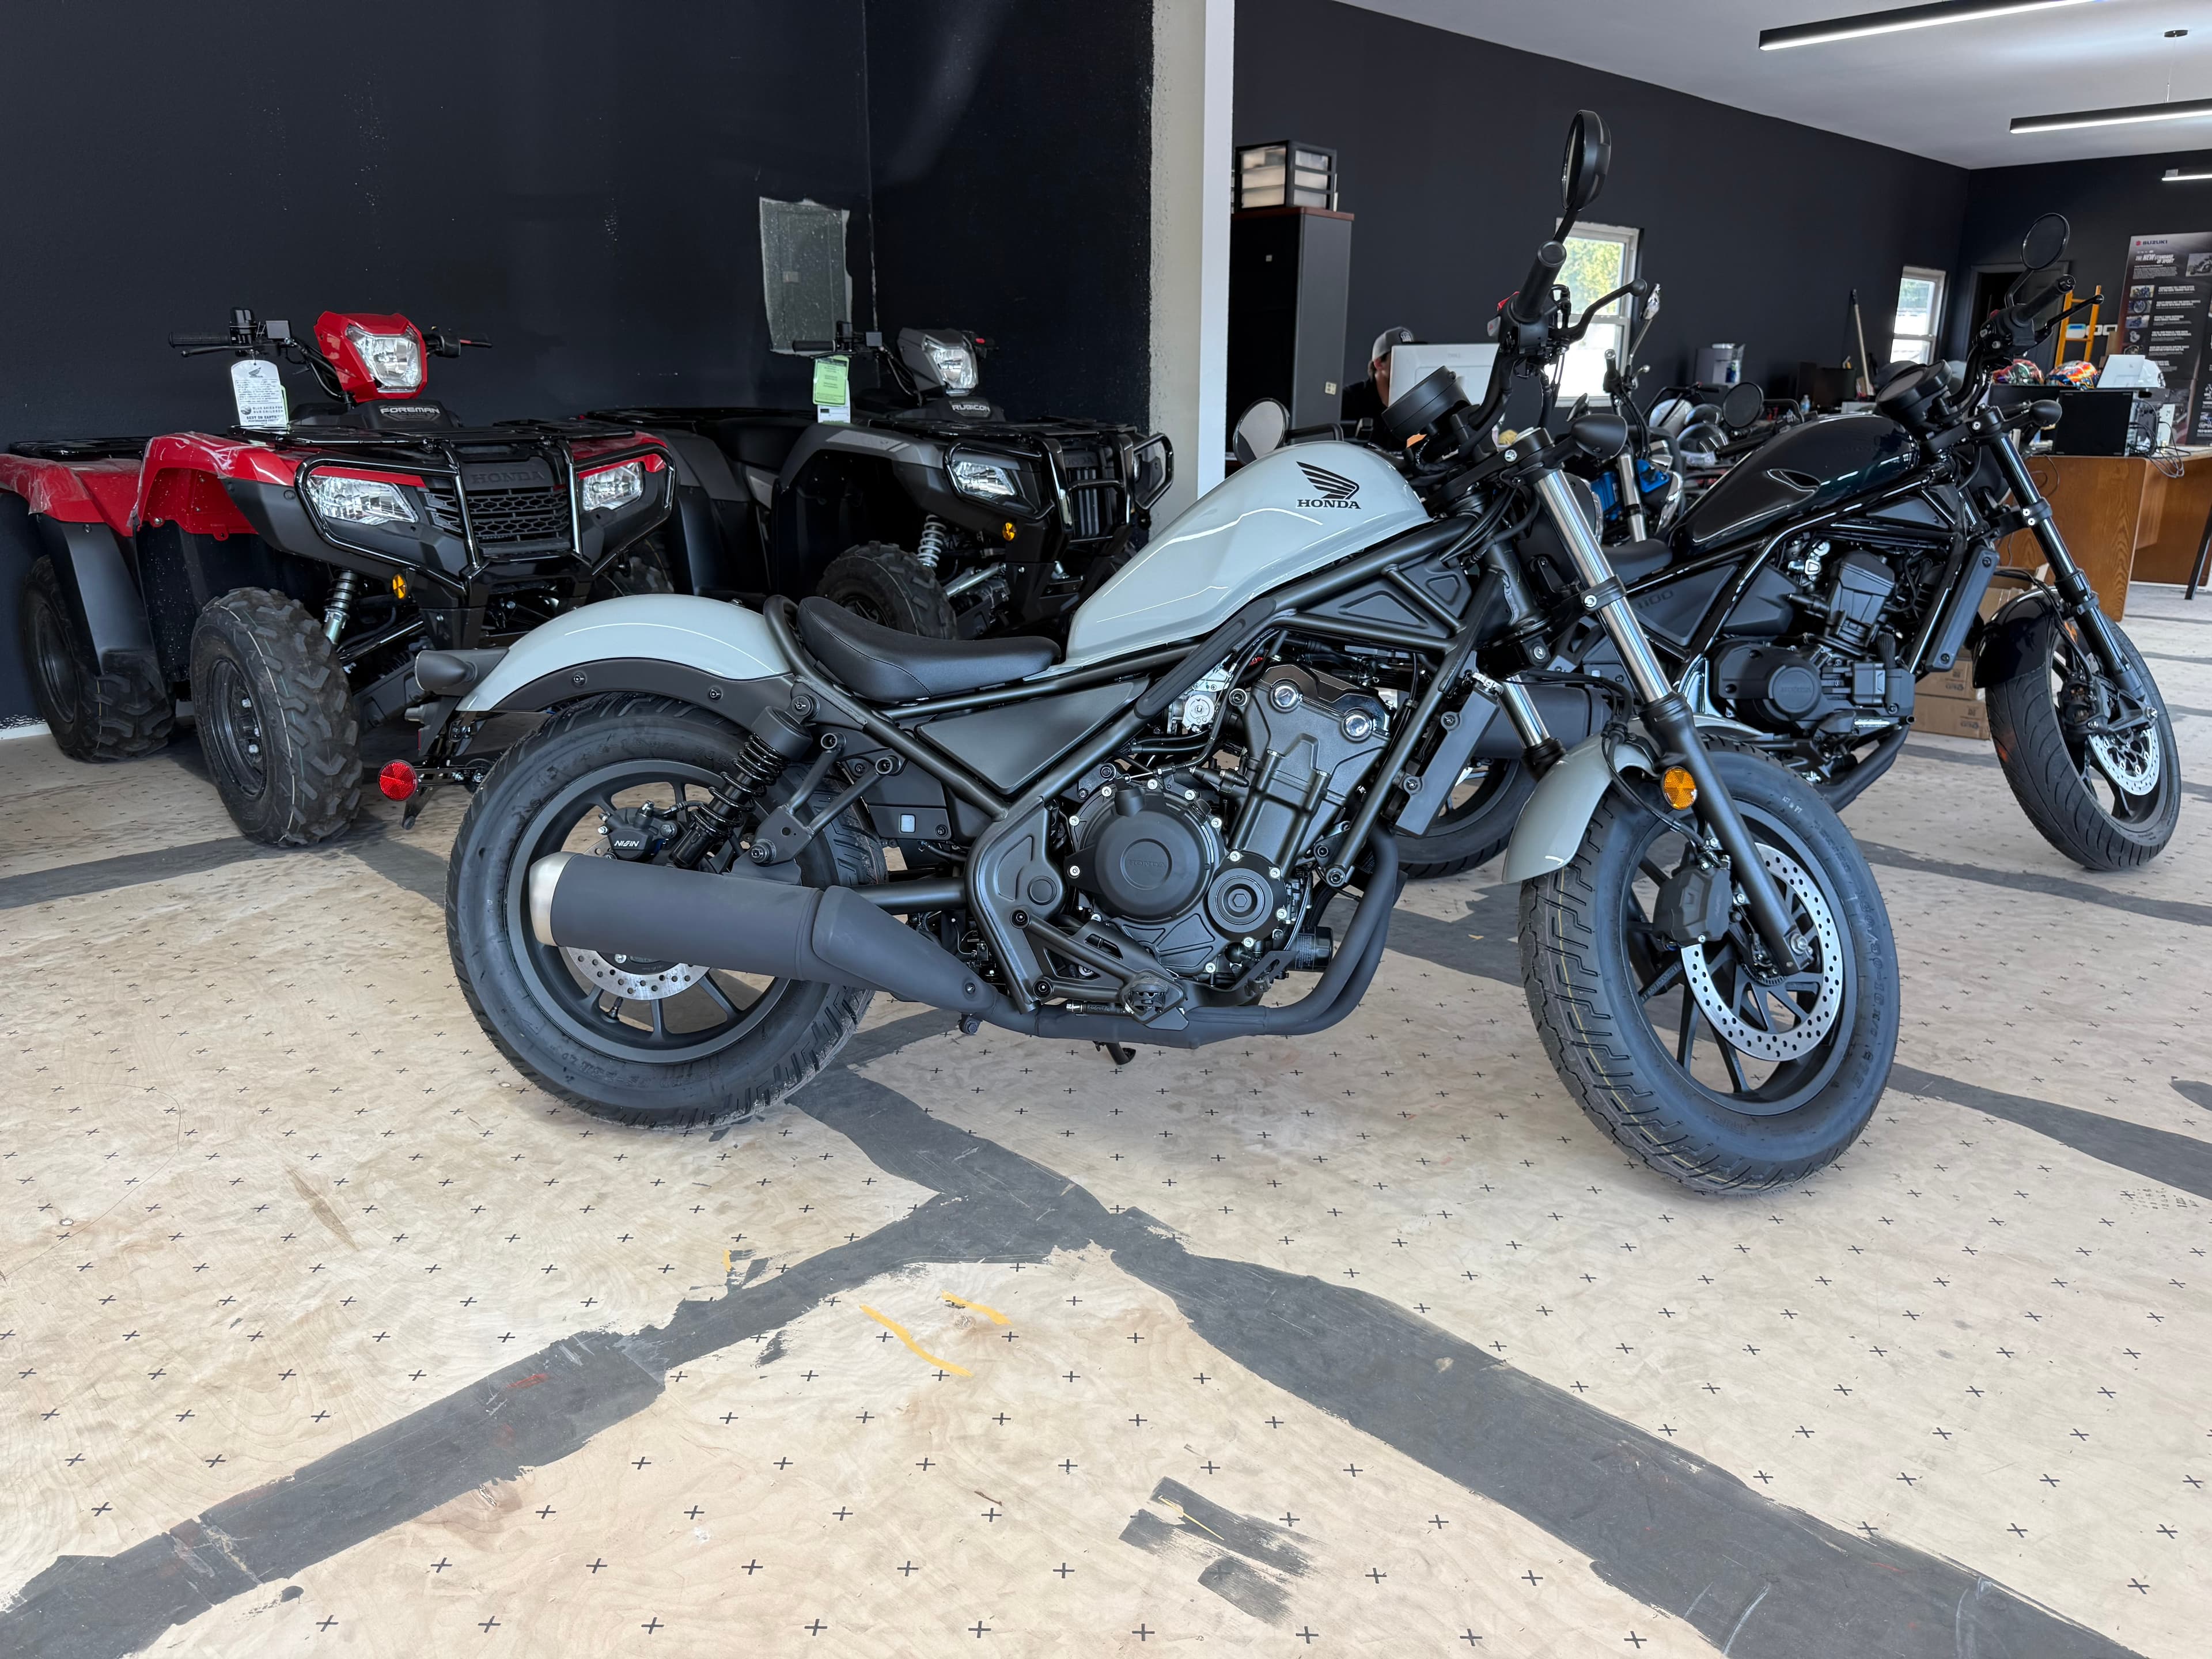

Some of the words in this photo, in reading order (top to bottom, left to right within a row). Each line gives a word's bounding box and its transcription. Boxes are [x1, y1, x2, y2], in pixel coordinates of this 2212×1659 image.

[471, 471, 545, 484] HONDA
[1297, 499, 1362, 509] HONDA
[1128, 858, 1167, 868] HONDA
